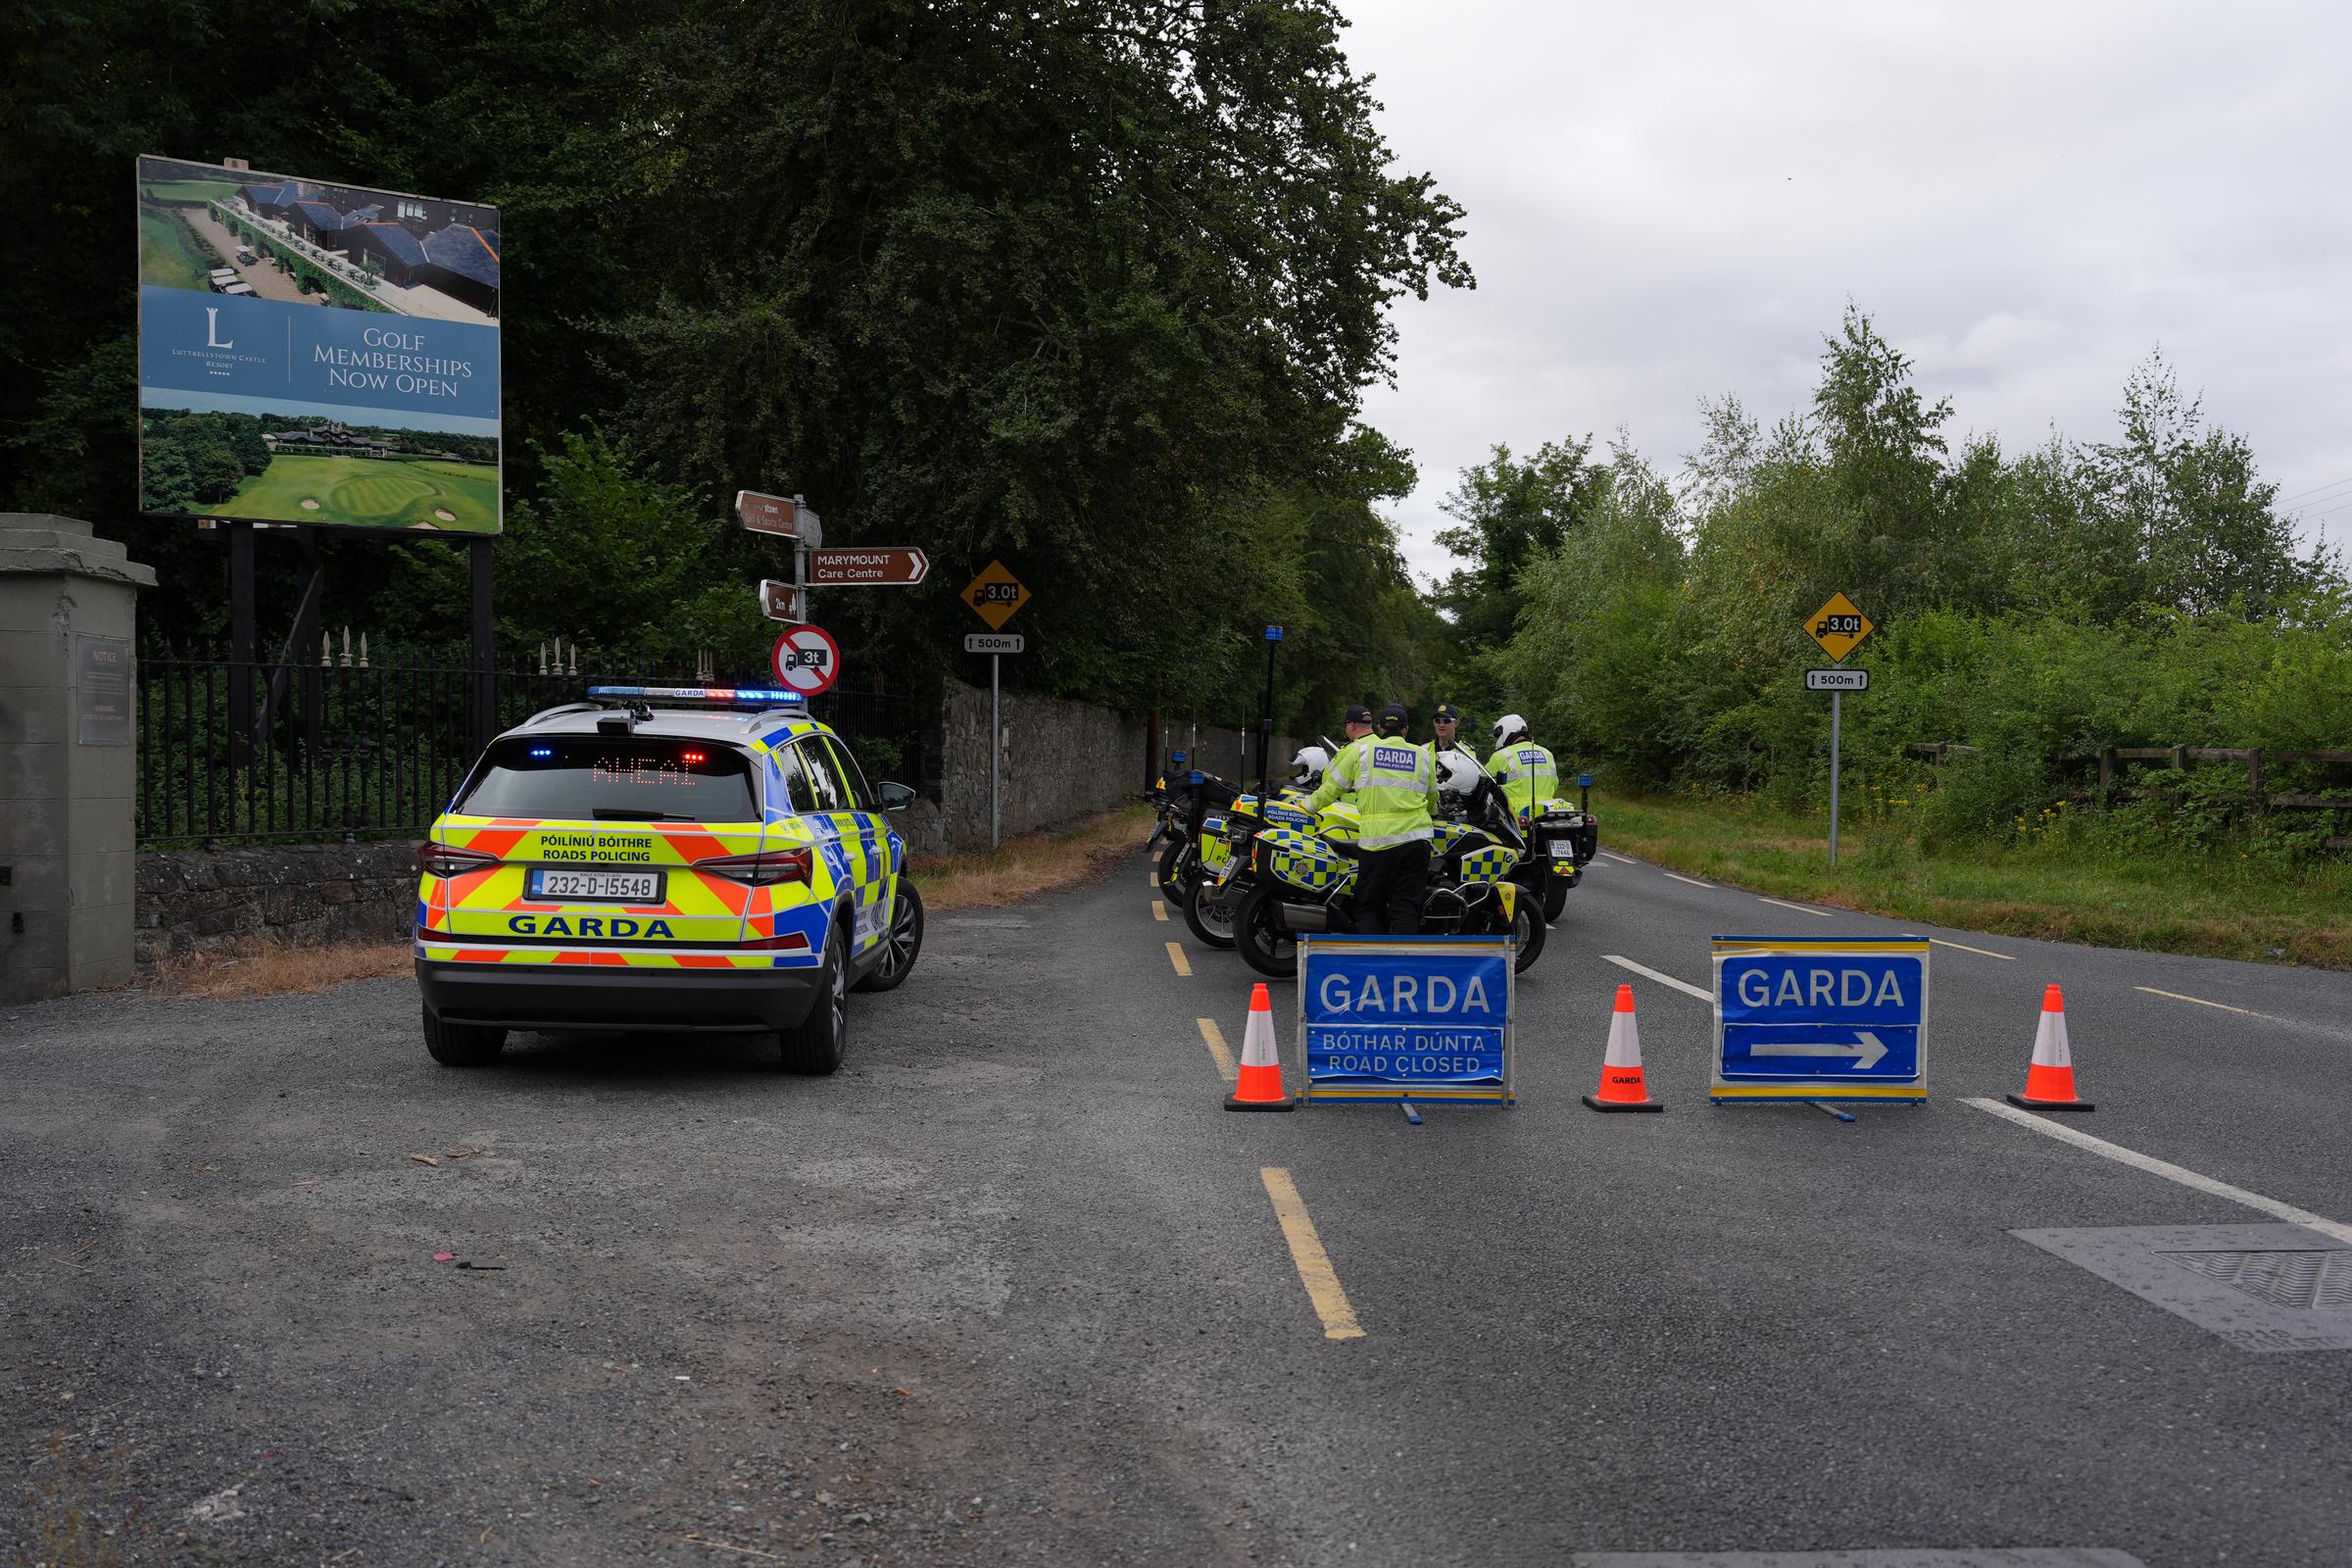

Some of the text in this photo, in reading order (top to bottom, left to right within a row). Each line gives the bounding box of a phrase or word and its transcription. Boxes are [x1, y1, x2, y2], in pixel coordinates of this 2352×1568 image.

[206, 307, 234, 349] L
[364, 327, 425, 351] GOLF
[238, 355, 267, 364] CASTLE
[314, 344, 472, 378] MEMBERSHIPS
[328, 368, 458, 397] NOW OPEN
[817, 555, 890, 565] MARYMOUNT
[817, 568, 884, 578] Care Centre
[988, 585, 1017, 599] 3.0t
[1830, 617, 1859, 631] 3.0t
[978, 639, 1011, 648] 500m
[94, 650, 118, 663] NOTICE
[804, 651, 819, 663] 3t
[1820, 675, 1853, 685] 500m
[1375, 749, 1414, 765] GARDA
[541, 834, 652, 849] PÓILÍNIÚ BÓITHRE
[543, 849, 651, 861] ROADS POLICING
[548, 876, 652, 897] 232-D-15548
[508, 915, 675, 939] GARDA
[1319, 973, 1491, 1013] GARDA
[1738, 968, 1905, 1007] GARDA
[1323, 1031, 1485, 1052] BÓTHAR DÚNTA
[1329, 1055, 1480, 1073] ROAD CLOSED
